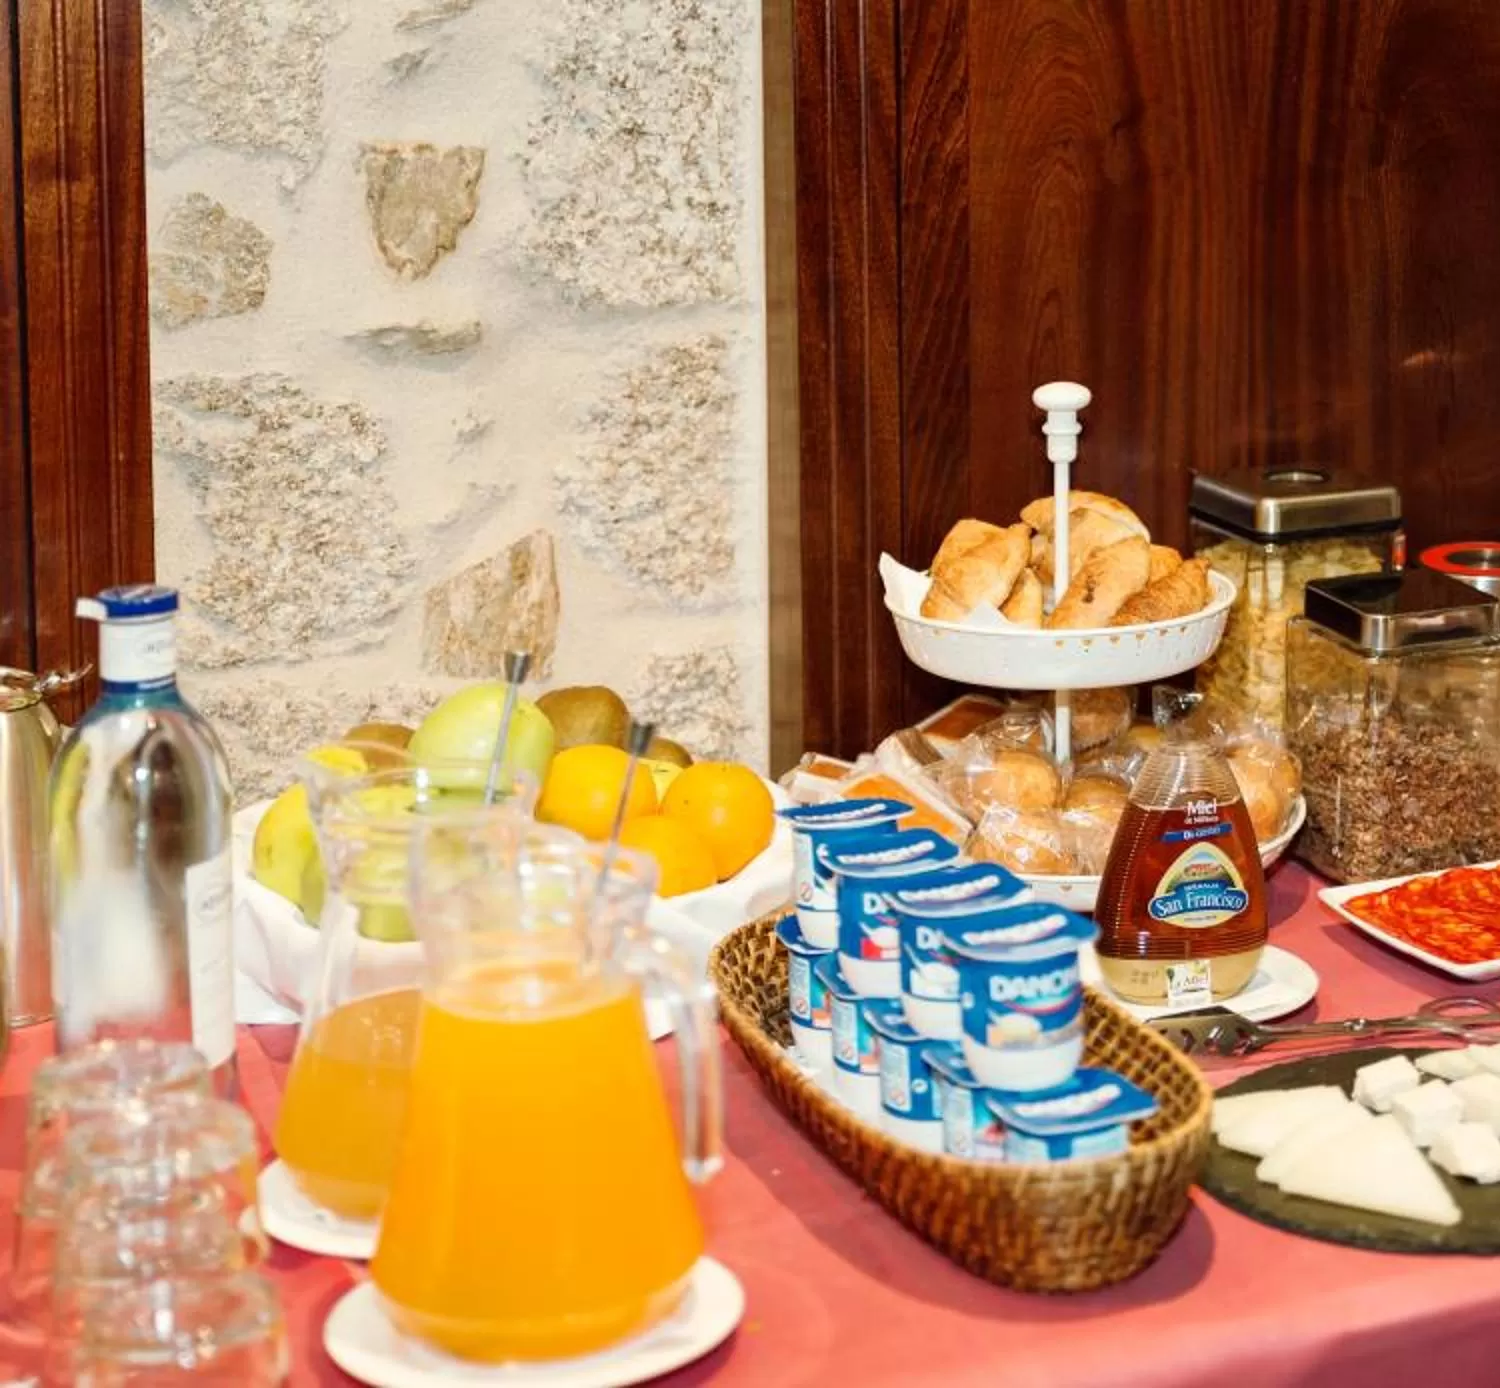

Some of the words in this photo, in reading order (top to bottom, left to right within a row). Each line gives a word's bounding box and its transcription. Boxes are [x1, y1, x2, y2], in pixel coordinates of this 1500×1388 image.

[1187, 797, 1217, 816] Miel
[1155, 899, 1183, 917] San
[1186, 891, 1243, 909] Francisco
[989, 966, 1079, 1003] DANO
